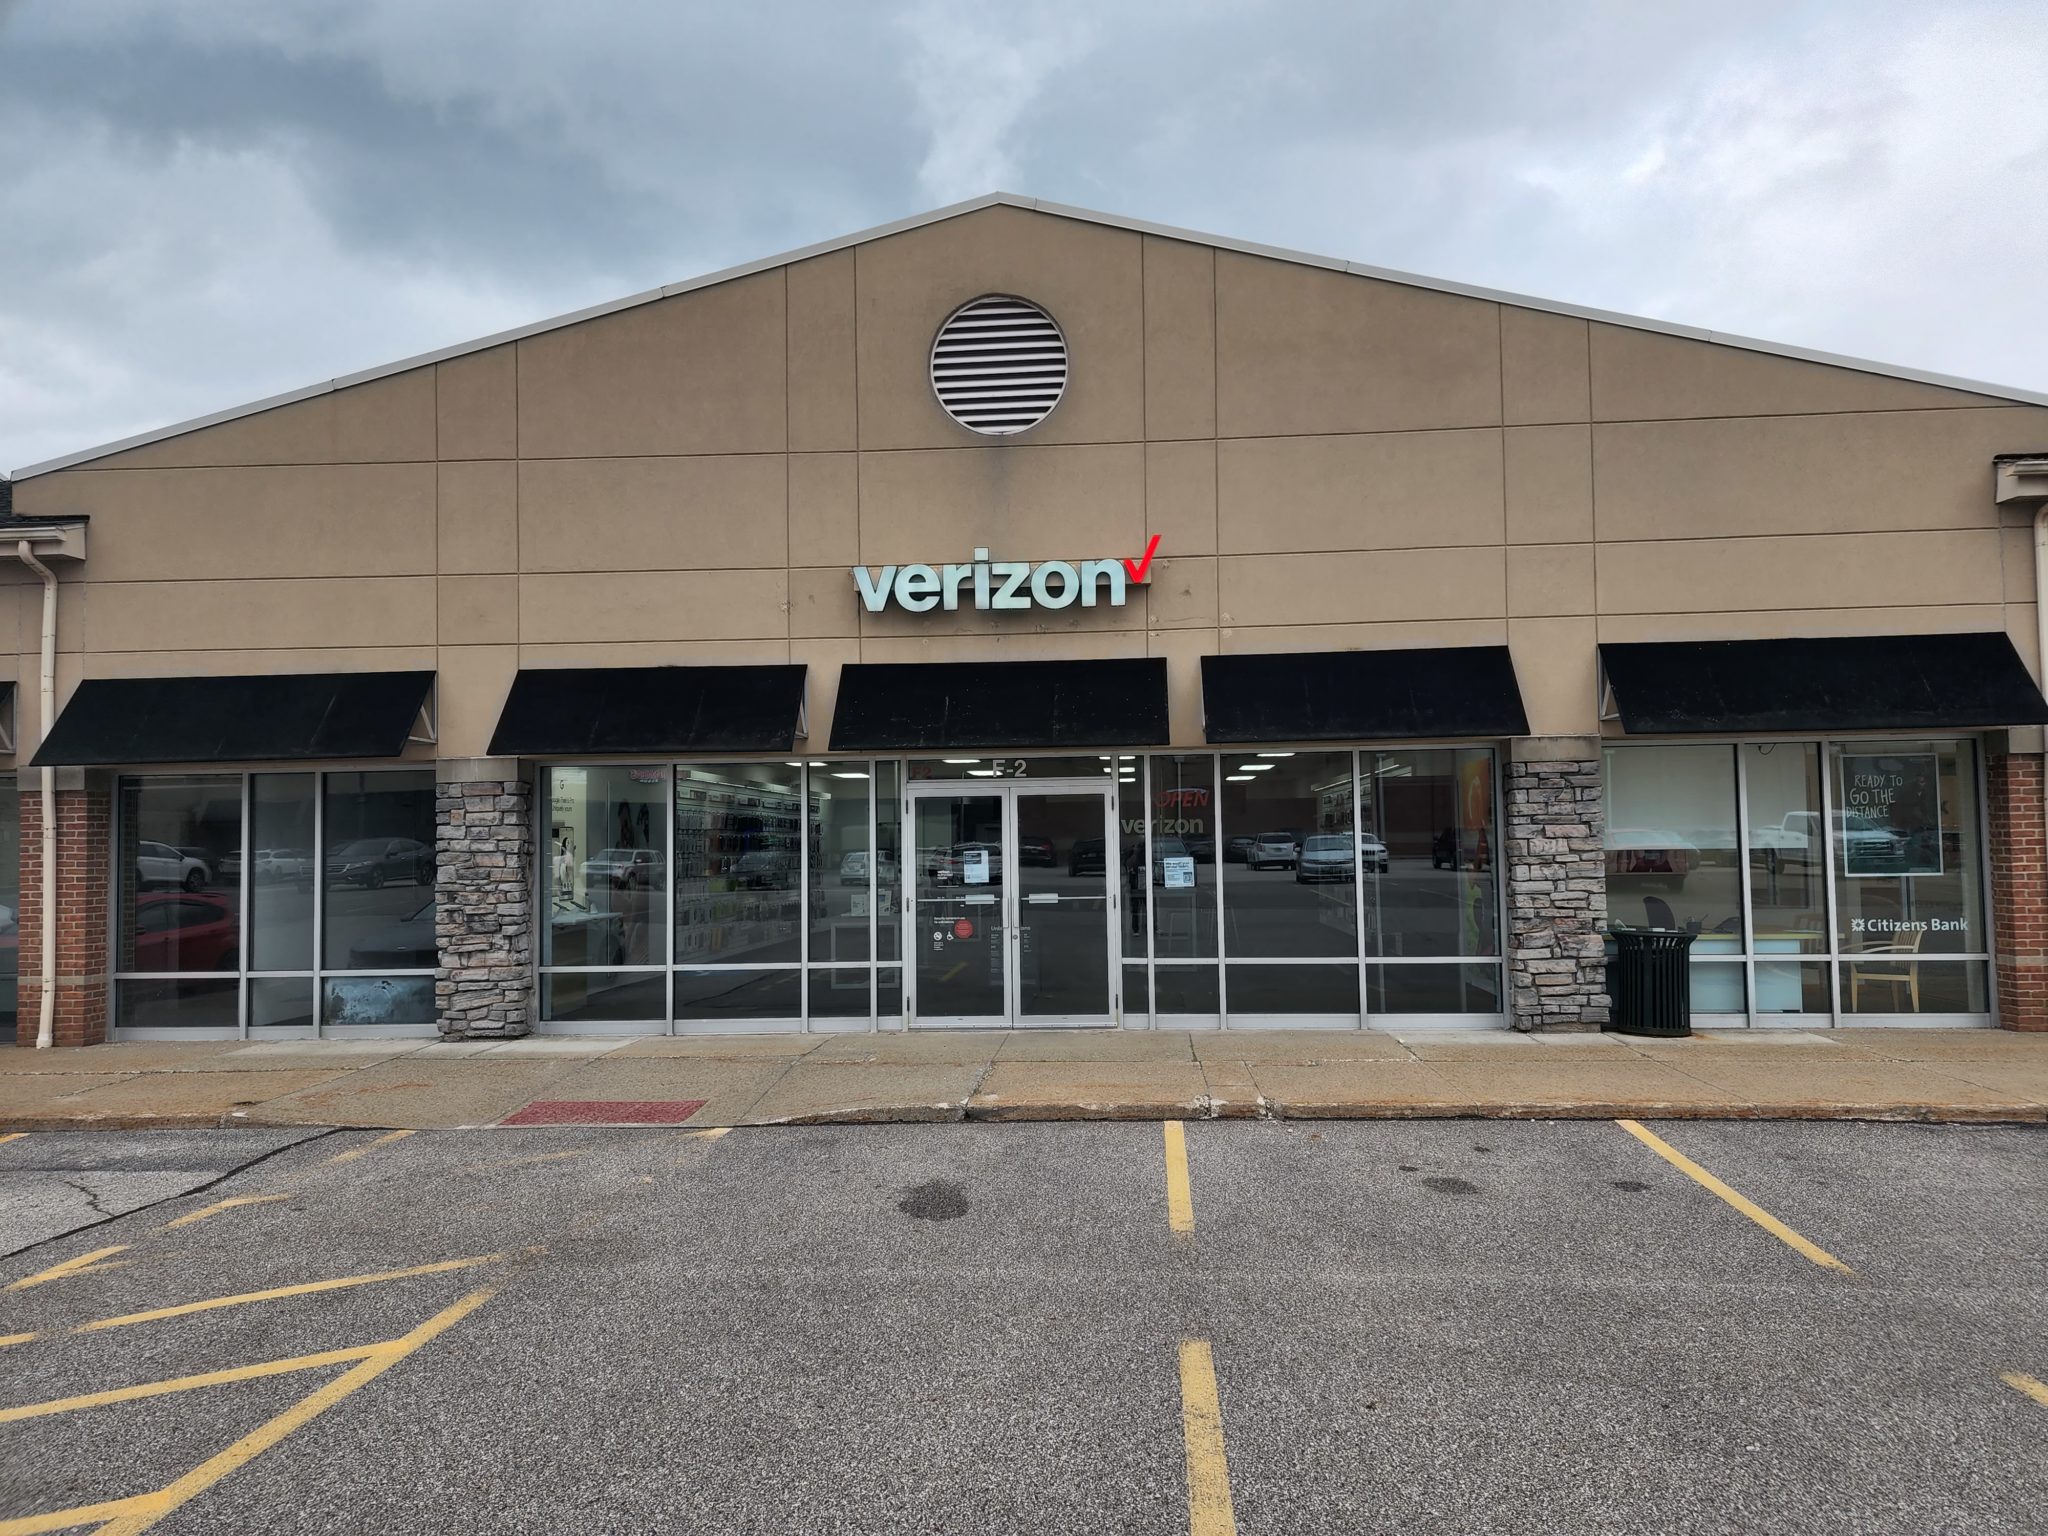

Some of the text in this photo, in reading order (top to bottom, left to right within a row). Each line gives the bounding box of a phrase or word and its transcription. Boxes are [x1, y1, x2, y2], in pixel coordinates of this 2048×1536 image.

[853, 547, 1126, 612] verizon
[992, 759, 1027, 778] F-2
[1854, 774, 1903, 788] READY TO
[1153, 791, 1209, 808] OPEN
[1850, 788, 1896, 805] GO THE
[1846, 805, 1889, 819] DISTANCE
[1121, 815, 1204, 834] verizon
[1867, 918, 1968, 932] Citizens Bank
